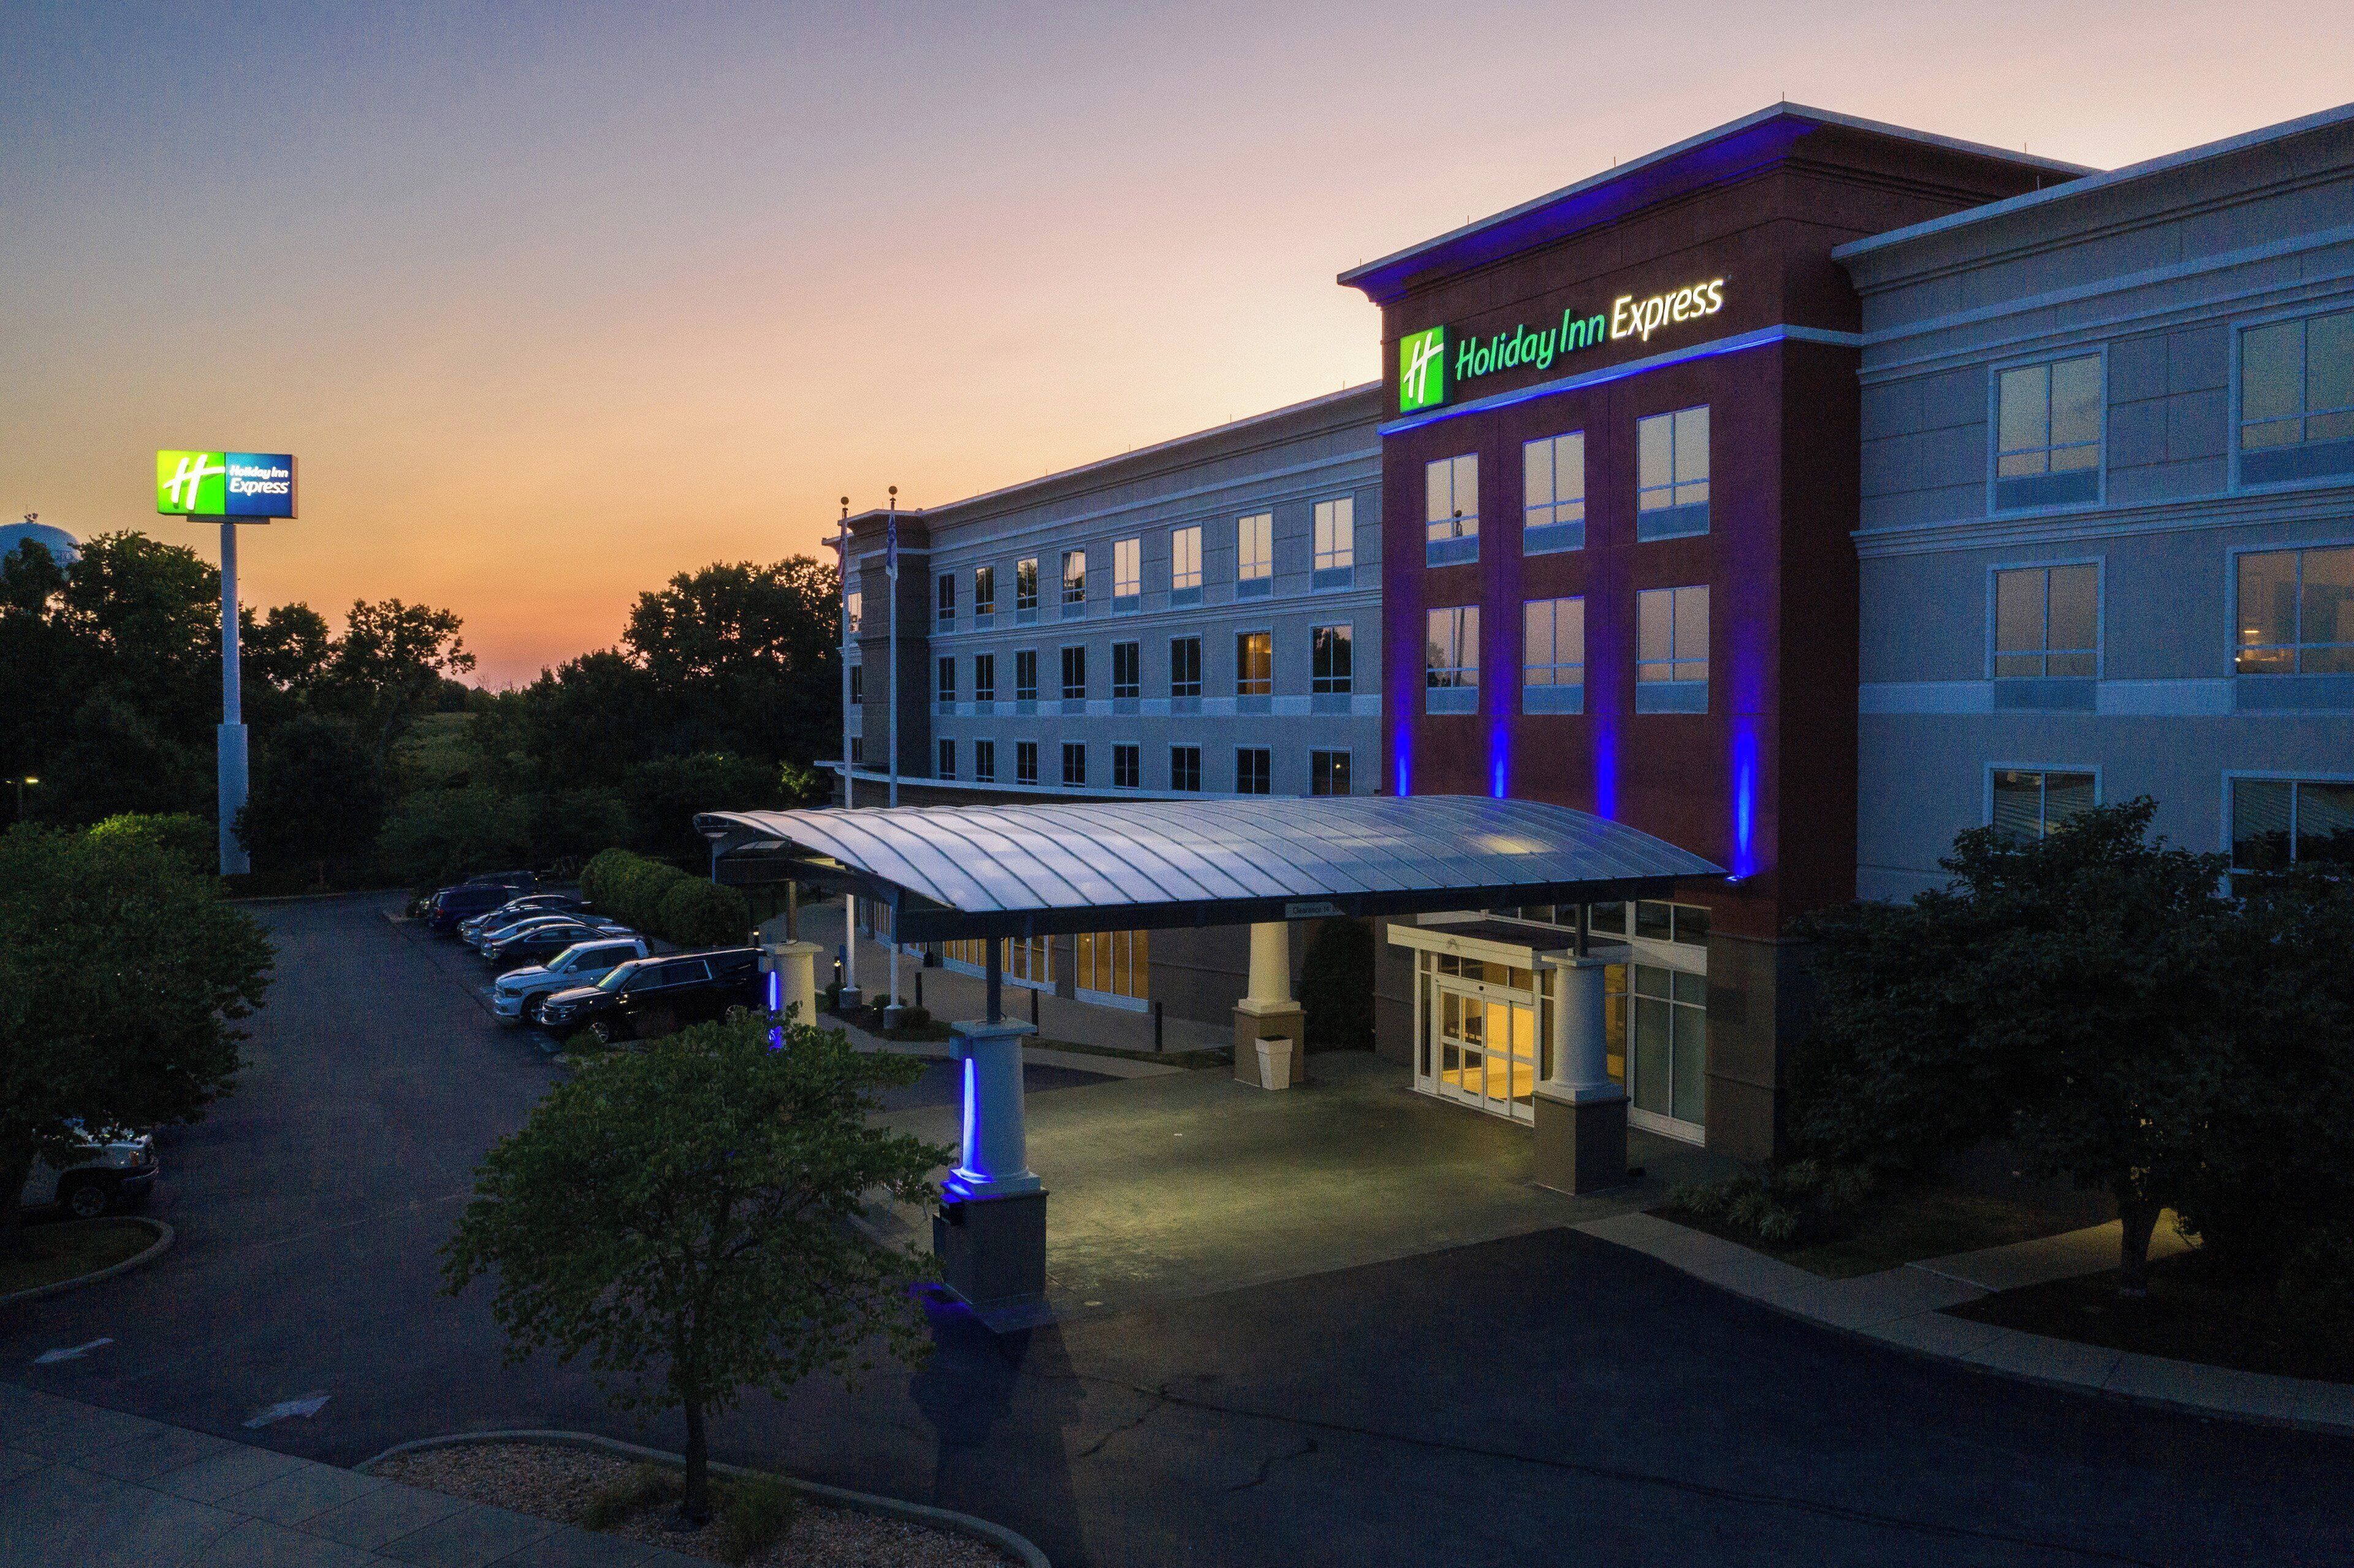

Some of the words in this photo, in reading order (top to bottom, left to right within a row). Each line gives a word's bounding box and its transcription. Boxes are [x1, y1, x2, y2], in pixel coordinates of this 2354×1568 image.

[1455, 324, 1556, 381] Holiday
[1560, 309, 1605, 352] Inn
[1610, 278, 1724, 341] Express
[229, 465, 271, 479] Holiday
[272, 466, 289, 478] Inn
[229, 478, 288, 496] Express
